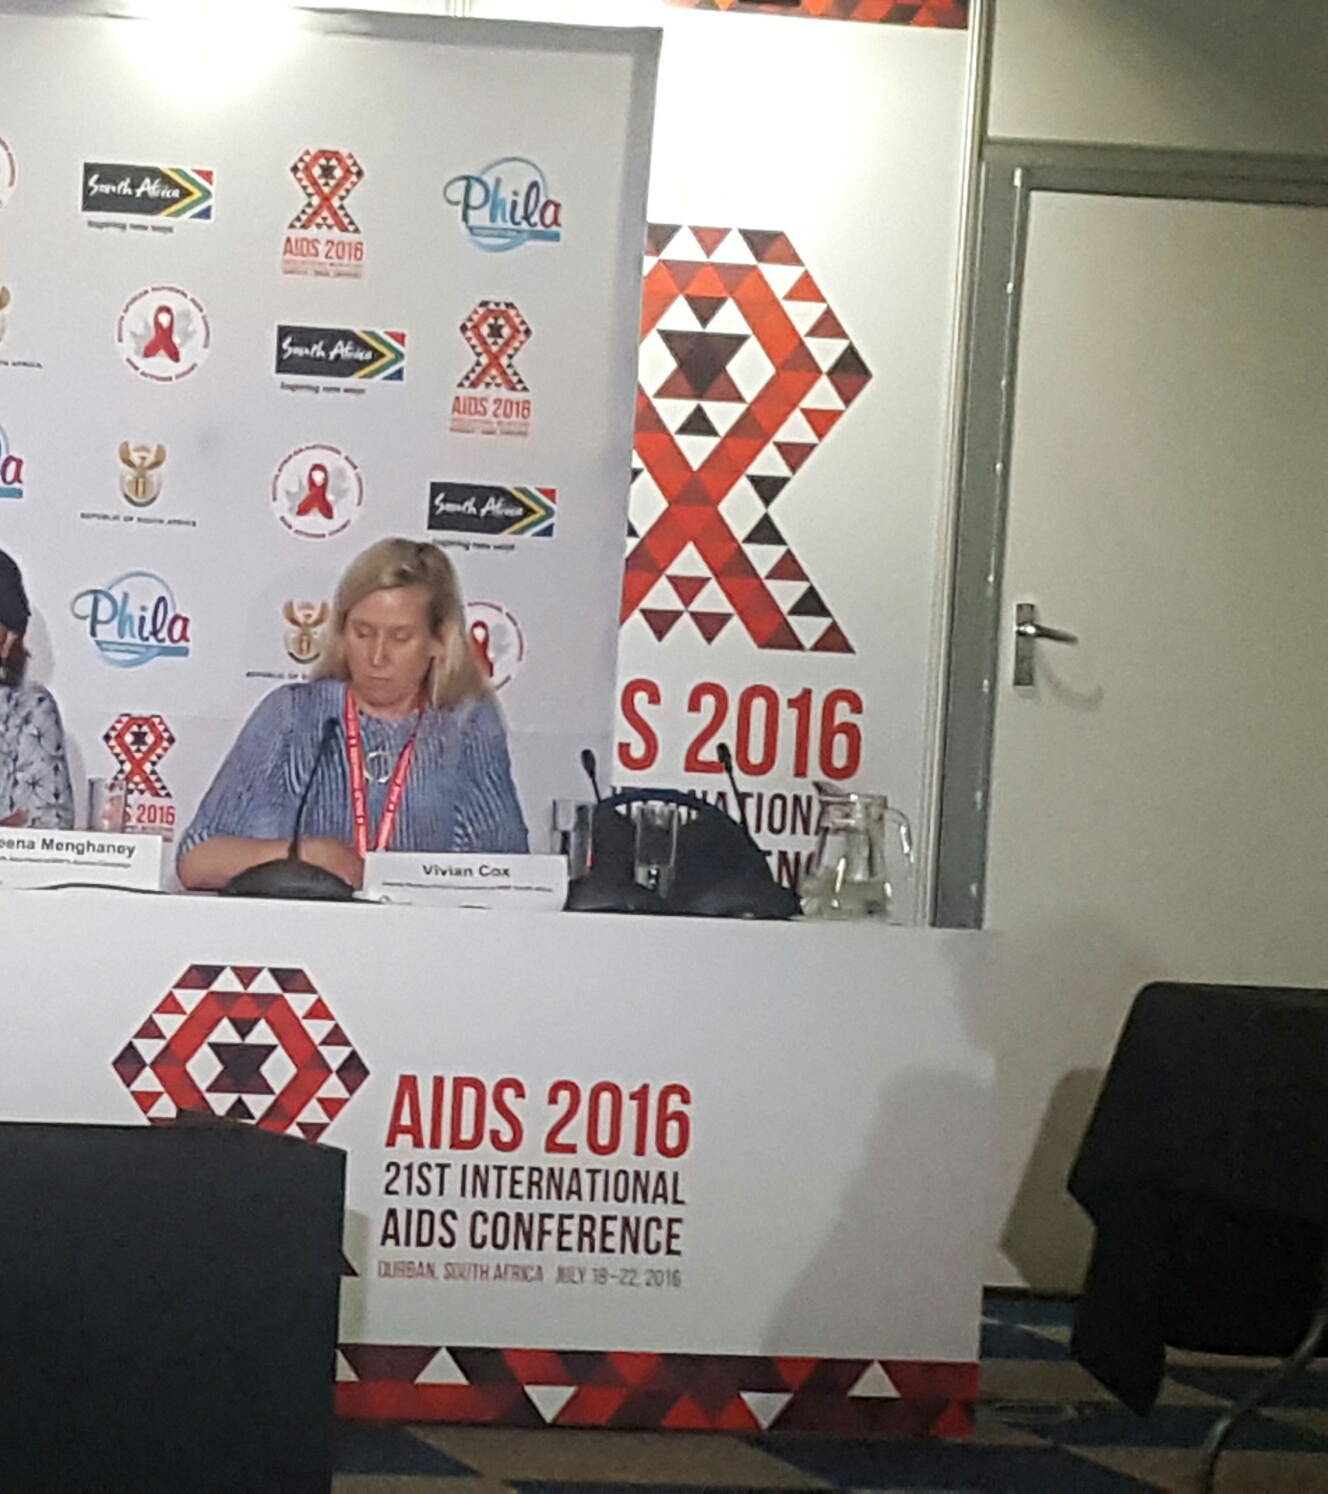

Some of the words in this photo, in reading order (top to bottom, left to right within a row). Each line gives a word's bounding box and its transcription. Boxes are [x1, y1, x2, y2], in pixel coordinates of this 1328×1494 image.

[88, 174, 132, 196] South
[135, 176, 180, 199] Africa
[442, 174, 562, 228] Phila
[283, 236, 321, 257] AIDS
[324, 239, 364, 261] 2016
[282, 336, 326, 359] South
[328, 339, 373, 361] Africa
[452, 395, 489, 416] AIDS
[493, 398, 531, 419] 2016
[72, 588, 190, 645] Phila
[683, 682, 864, 780] 2016
[136, 803, 176, 826] 2016
[40, 838, 136, 858] Menghaney
[421, 863, 473, 877] Vivian
[478, 864, 512, 878] Cox
[384, 1073, 528, 1153] AIDS
[544, 1080, 692, 1159] 2016
[383, 1160, 452, 1197] 21ST
[459, 1162, 687, 1206] INTERNATIONAL
[379, 1206, 460, 1249] AIDS
[469, 1209, 684, 1257] CONFERENCE
[443, 1261, 490, 1281] SOUTH
[492, 1263, 545, 1283] AFRICA
